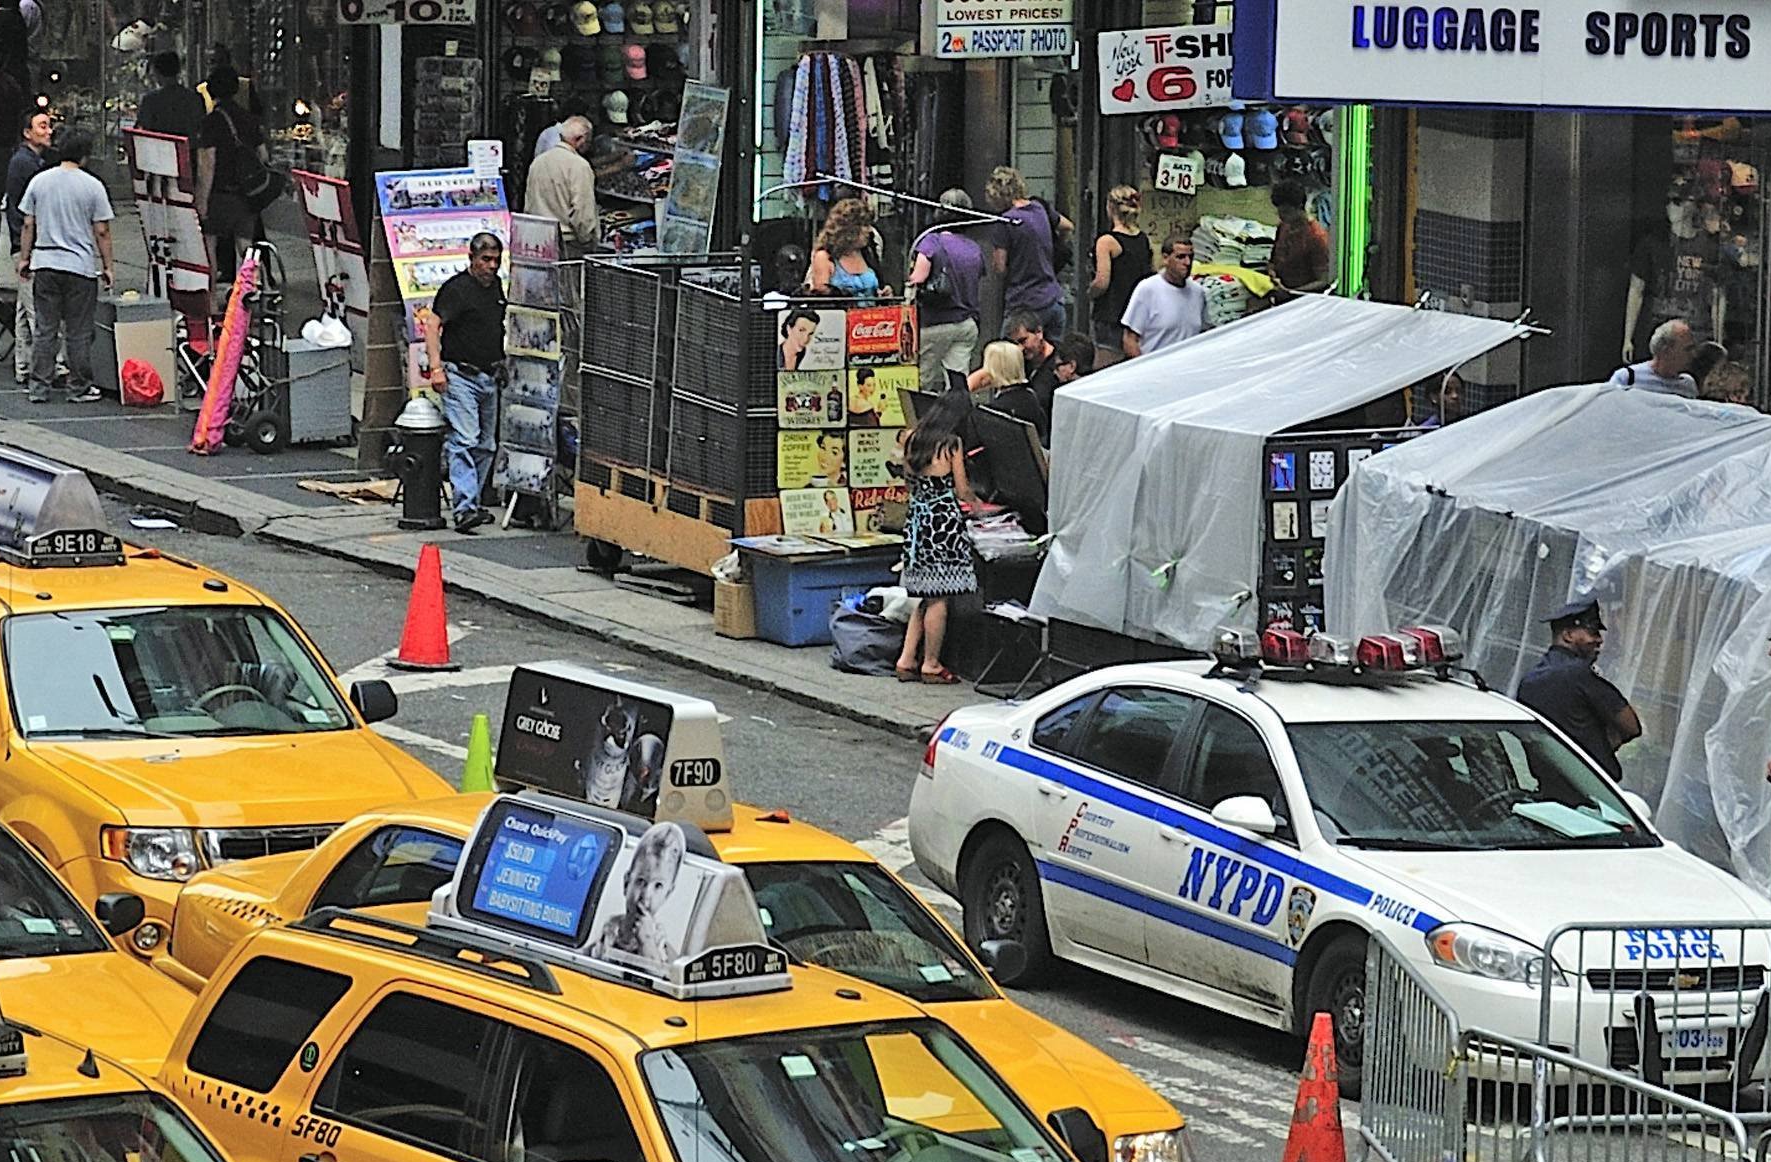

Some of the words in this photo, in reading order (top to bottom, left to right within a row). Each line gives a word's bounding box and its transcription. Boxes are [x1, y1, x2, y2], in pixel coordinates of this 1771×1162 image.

[947, 8, 1001, 21] LOWEST
[1010, 8, 1062, 20] PRICES!
[971, 29, 1026, 52] PASSPORT
[1031, 27, 1068, 51] PHOTO
[1351, 6, 1539, 52] LUGGAGE
[1585, 9, 1751, 60] SPORTS
[1146, 66, 1197, 101] 6
[783, 434, 809, 442] DRINK
[54, 534, 95, 553] 9E18
[516, 714, 535, 733] GREY
[535, 718, 562, 741] GOOSE
[674, 760, 714, 785] 7F90
[1076, 802, 1115, 829] COURTESY
[504, 816, 530, 833] Chase
[530, 822, 569, 846] QuickPay
[1067, 818, 1131, 854] PROFESSIONALISM
[1058, 835, 1093, 861] RESPECT
[495, 867, 541, 892] JENNIFER
[1178, 847, 1284, 926] NYPD
[488, 890, 542, 921] BABYSITTING
[541, 903, 573, 927] BONUS
[1370, 893, 1417, 926] POLICE
[712, 952, 756, 977] 5F80
[1624, 941, 1725, 963] POLICE
[291, 1114, 342, 1148] 5F80
